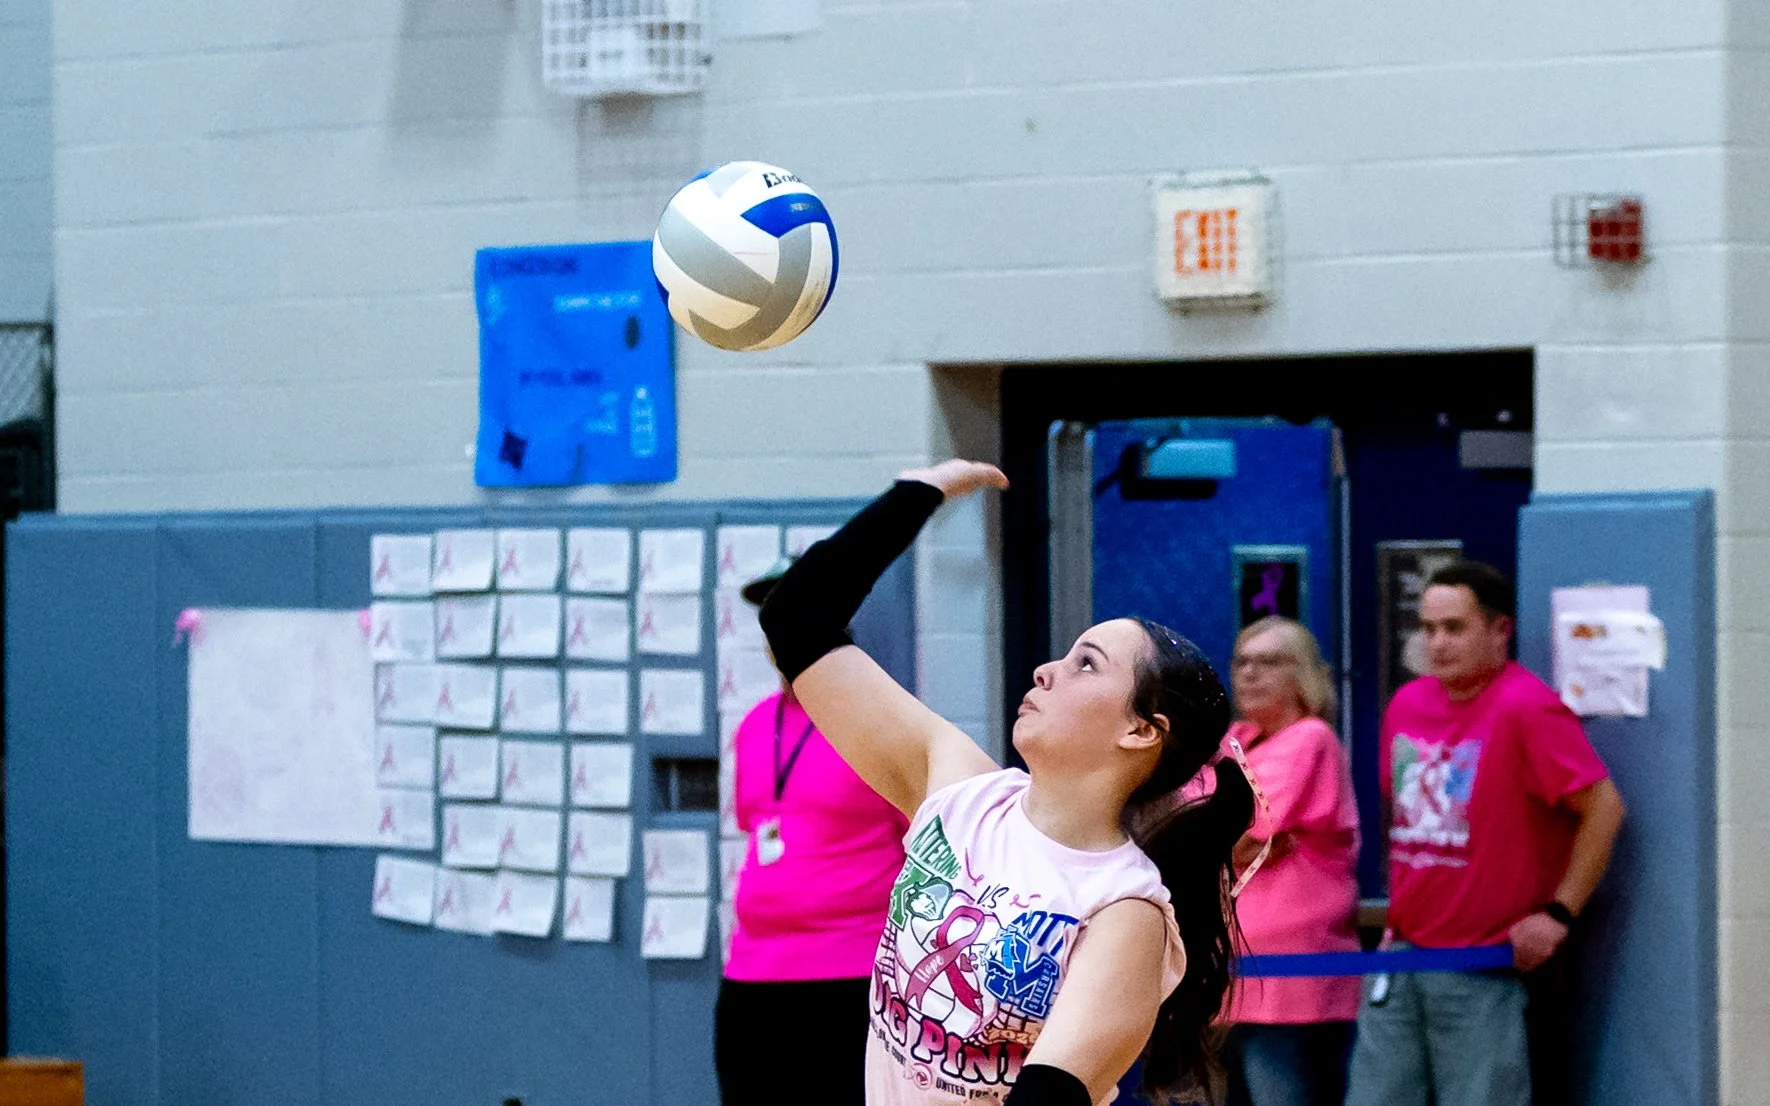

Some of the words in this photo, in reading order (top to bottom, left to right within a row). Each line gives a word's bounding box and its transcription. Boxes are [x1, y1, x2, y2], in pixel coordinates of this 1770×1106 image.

[1011, 910, 1081, 957] MOTT
[914, 954, 945, 984] Hope
[935, 1077, 966, 1097] UNITED
